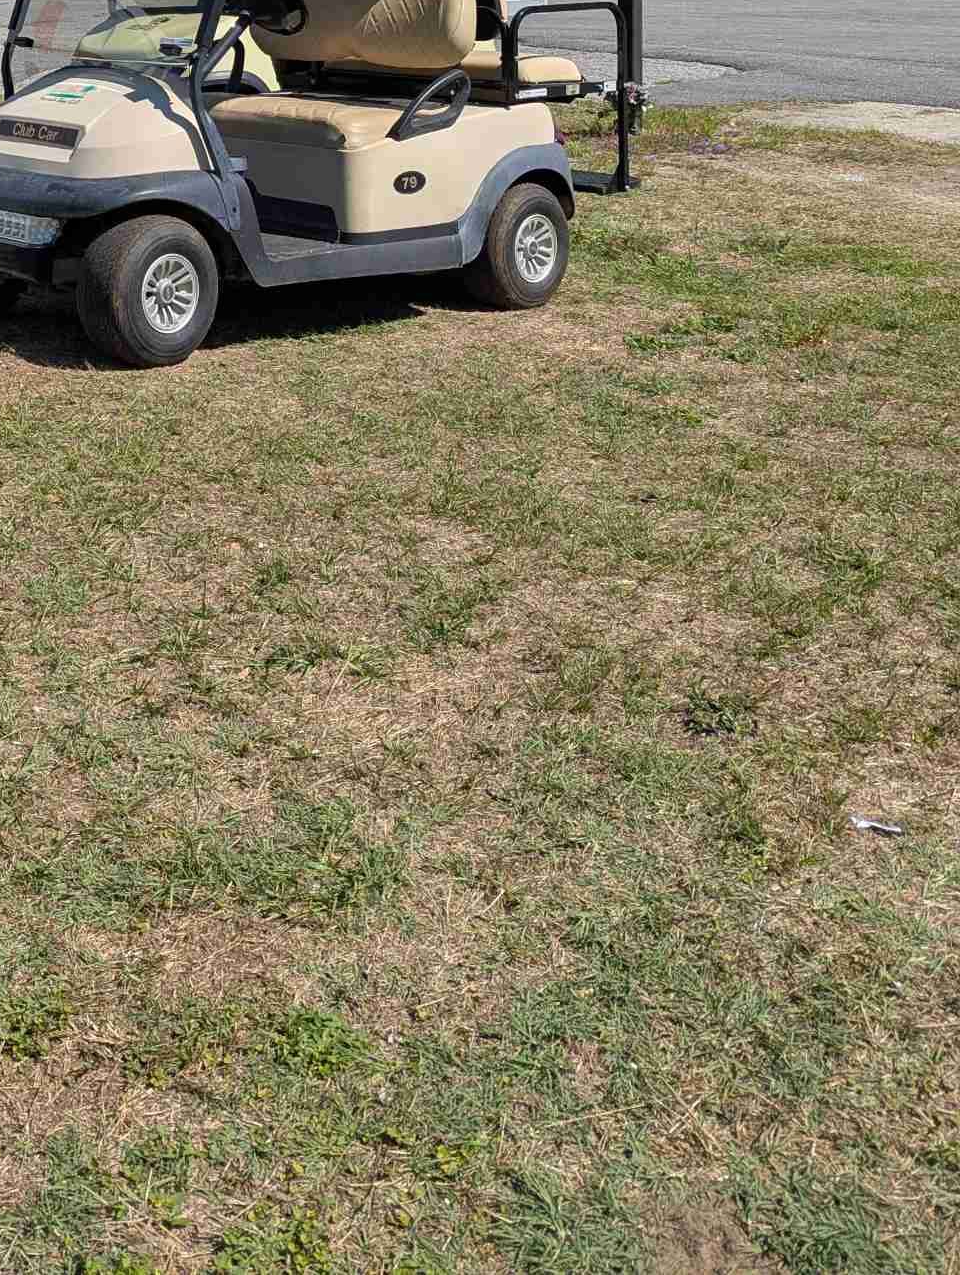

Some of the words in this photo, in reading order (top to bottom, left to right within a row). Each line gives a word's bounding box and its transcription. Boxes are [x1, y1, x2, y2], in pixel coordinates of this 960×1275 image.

[13, 123, 35, 138] Club
[39, 126, 59, 140] Car
[401, 176, 417, 190] 79
